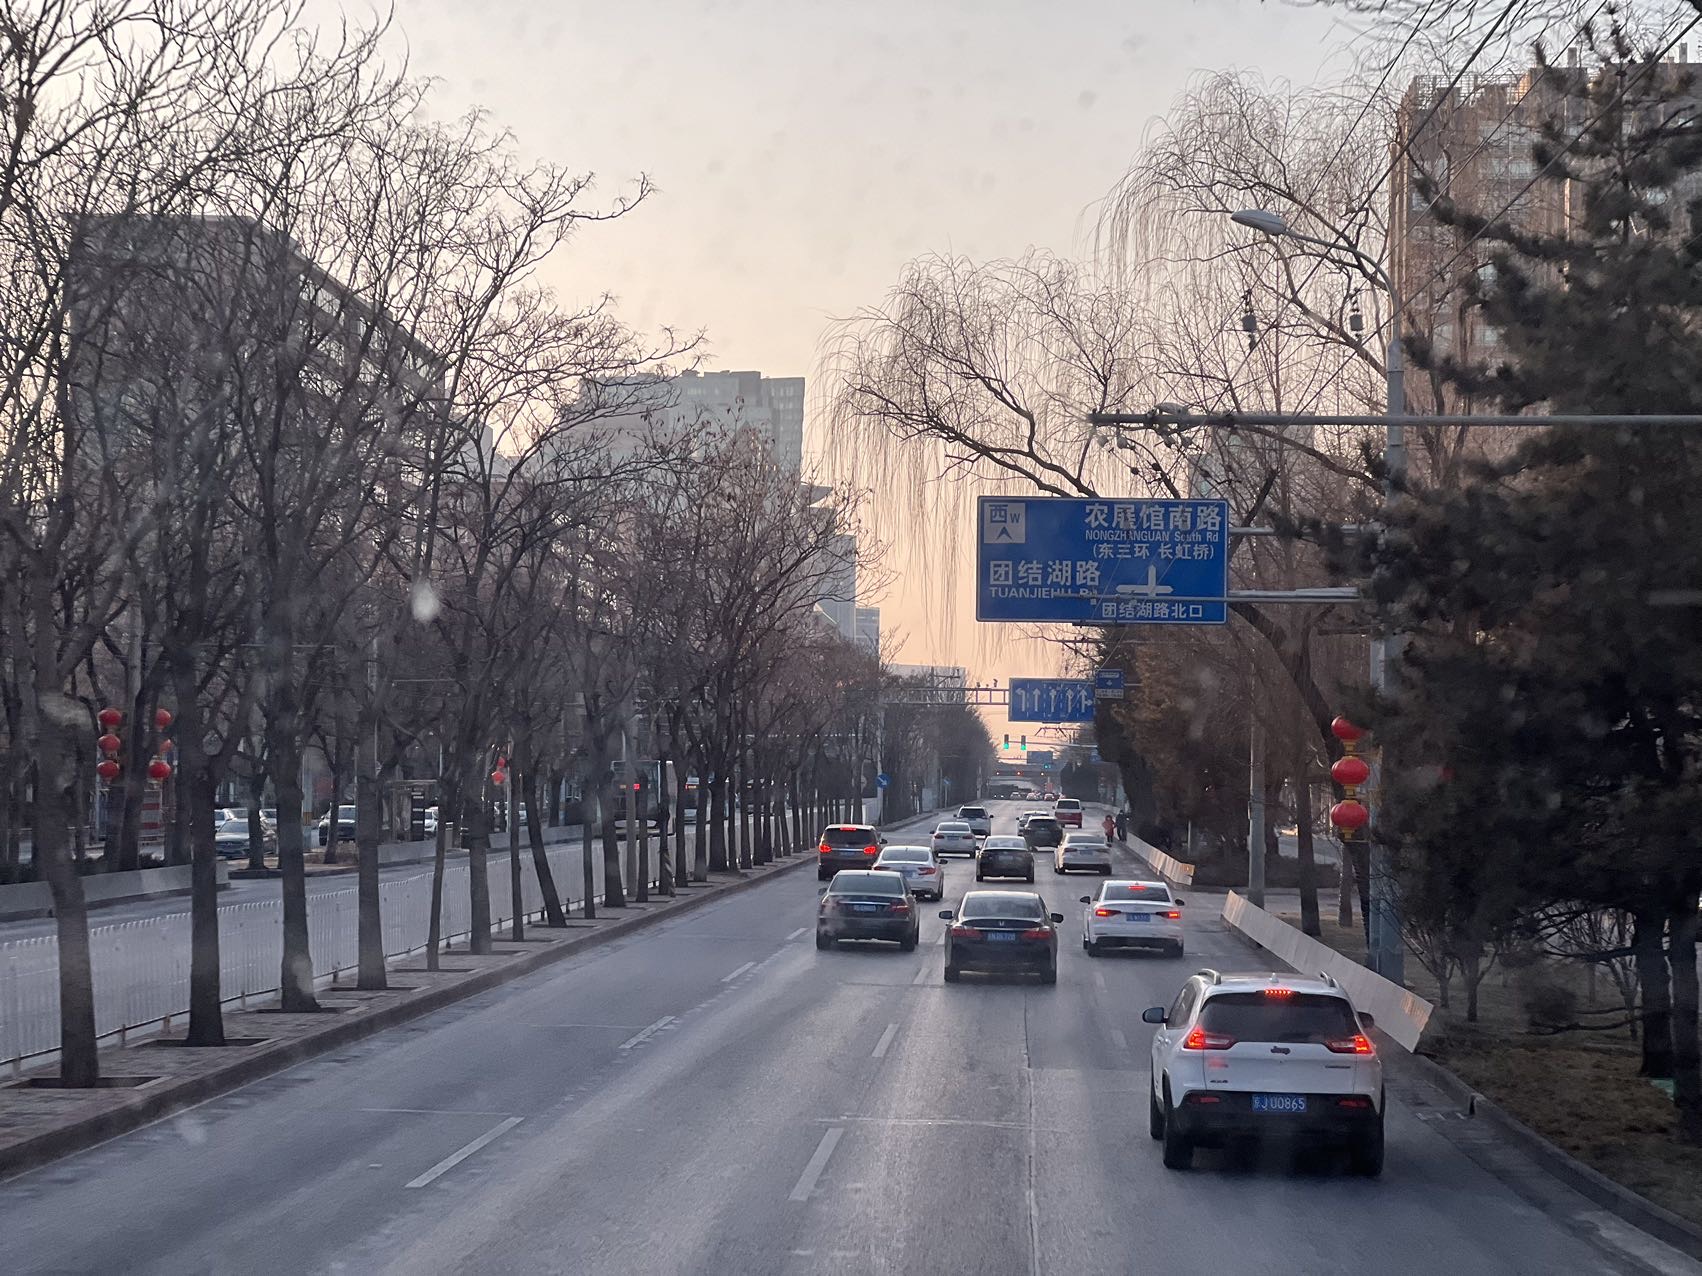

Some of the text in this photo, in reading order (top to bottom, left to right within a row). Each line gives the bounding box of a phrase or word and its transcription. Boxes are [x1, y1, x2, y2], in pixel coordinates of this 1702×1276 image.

[989, 504, 1008, 523] 西
[1010, 513, 1020, 523] W
[1084, 503, 1221, 531] 农展馆南路
[1085, 530, 1219, 542] NONGZHANGUAN South Rd
[990, 560, 1101, 586] 团结湖路
[1102, 602, 1203, 619] 团结湖路北口
